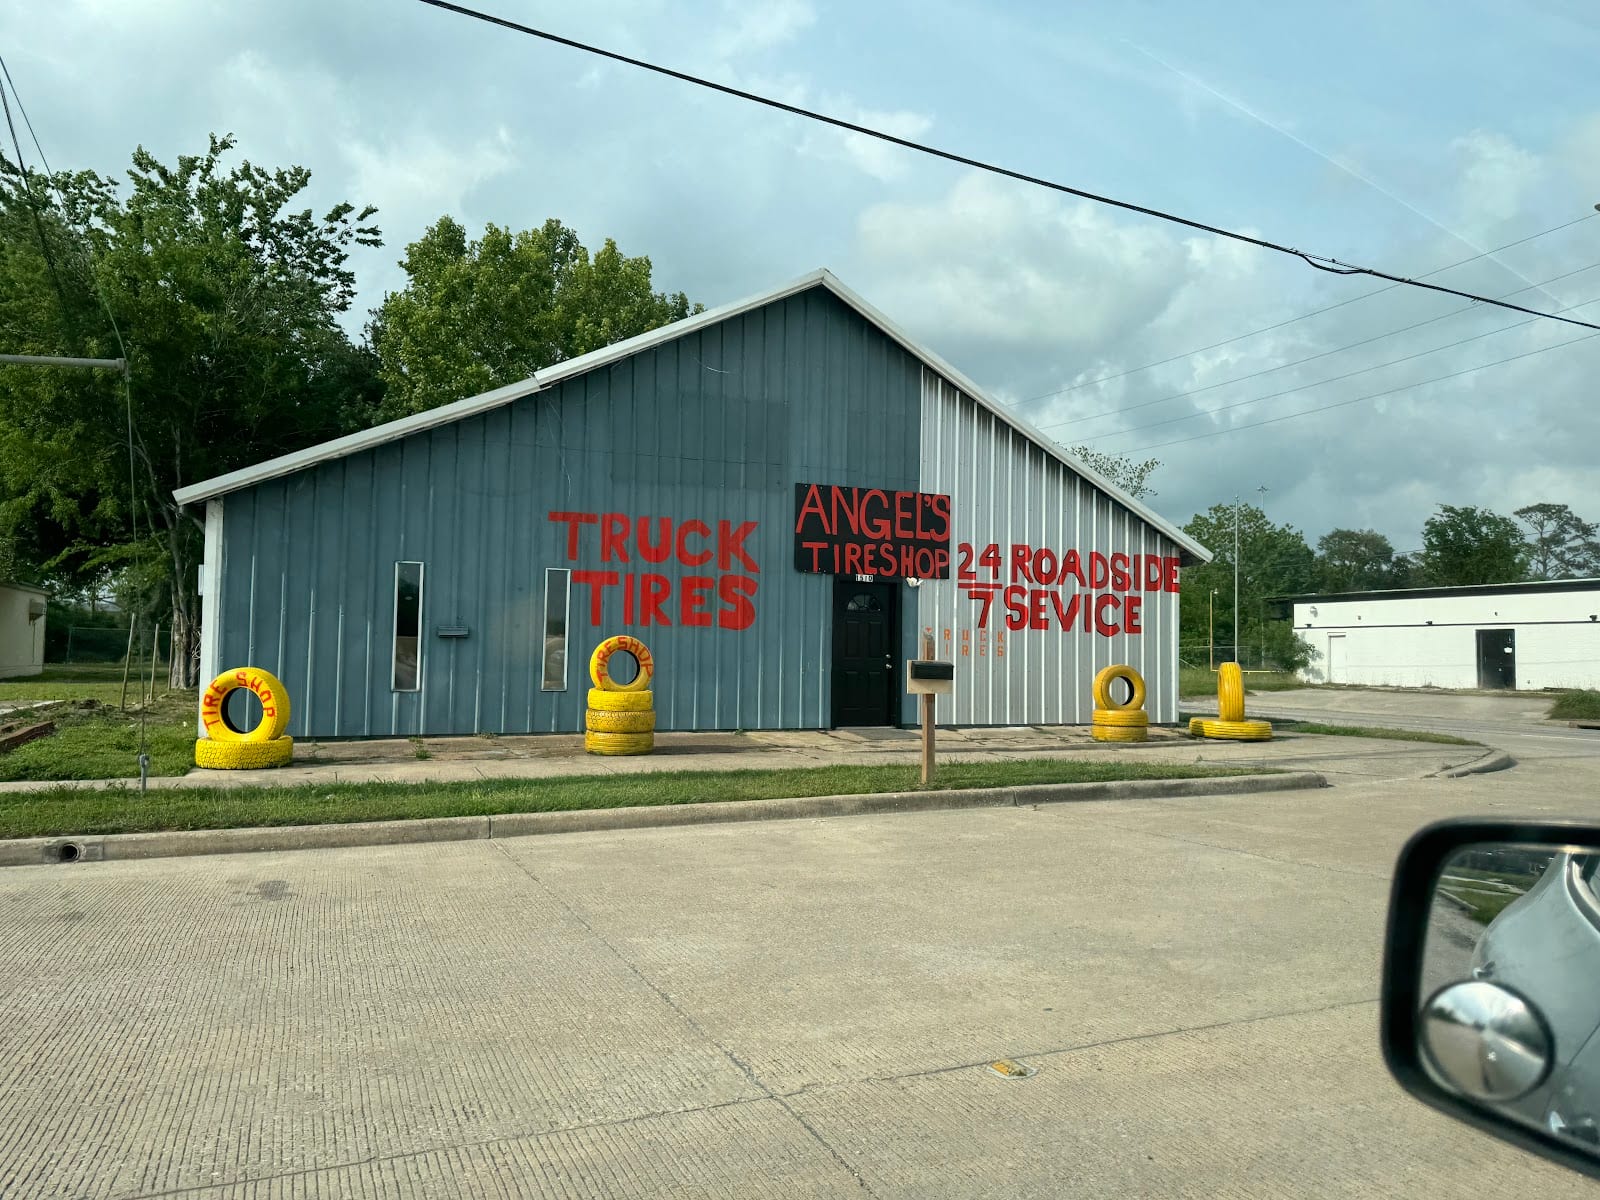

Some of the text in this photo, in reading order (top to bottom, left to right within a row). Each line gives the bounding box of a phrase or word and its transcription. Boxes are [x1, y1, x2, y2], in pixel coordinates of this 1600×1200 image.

[548, 511, 760, 573] TRUCK
[795, 484, 950, 542] ANGEL'S
[957, 542, 1180, 593] 24 ROADSIDE
[571, 569, 759, 630] TIRES
[968, 585, 1142, 637] 7 SEVICE
[945, 643, 1004, 657] IRES
[202, 671, 276, 730] TIRE SHOP
